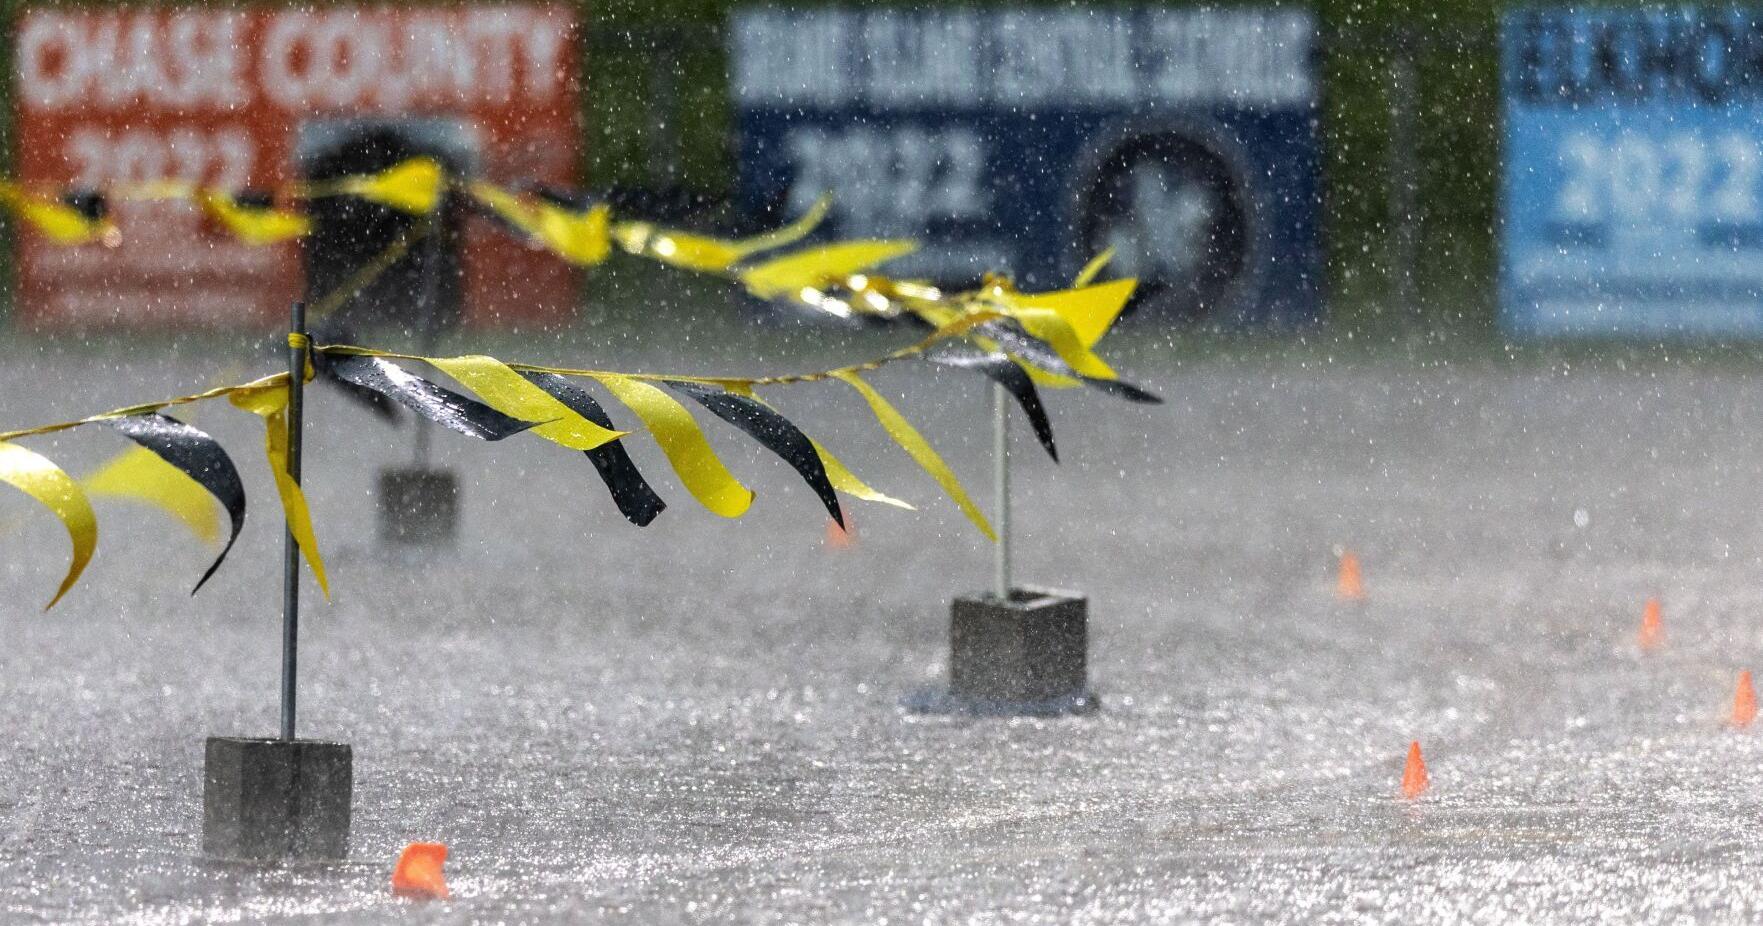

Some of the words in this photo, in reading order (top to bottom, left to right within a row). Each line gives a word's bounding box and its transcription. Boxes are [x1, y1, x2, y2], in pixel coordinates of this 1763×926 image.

[18, 10, 252, 107] CHASE
[262, 10, 572, 107] COUNTY
[1556, 132, 1758, 219] 2022
